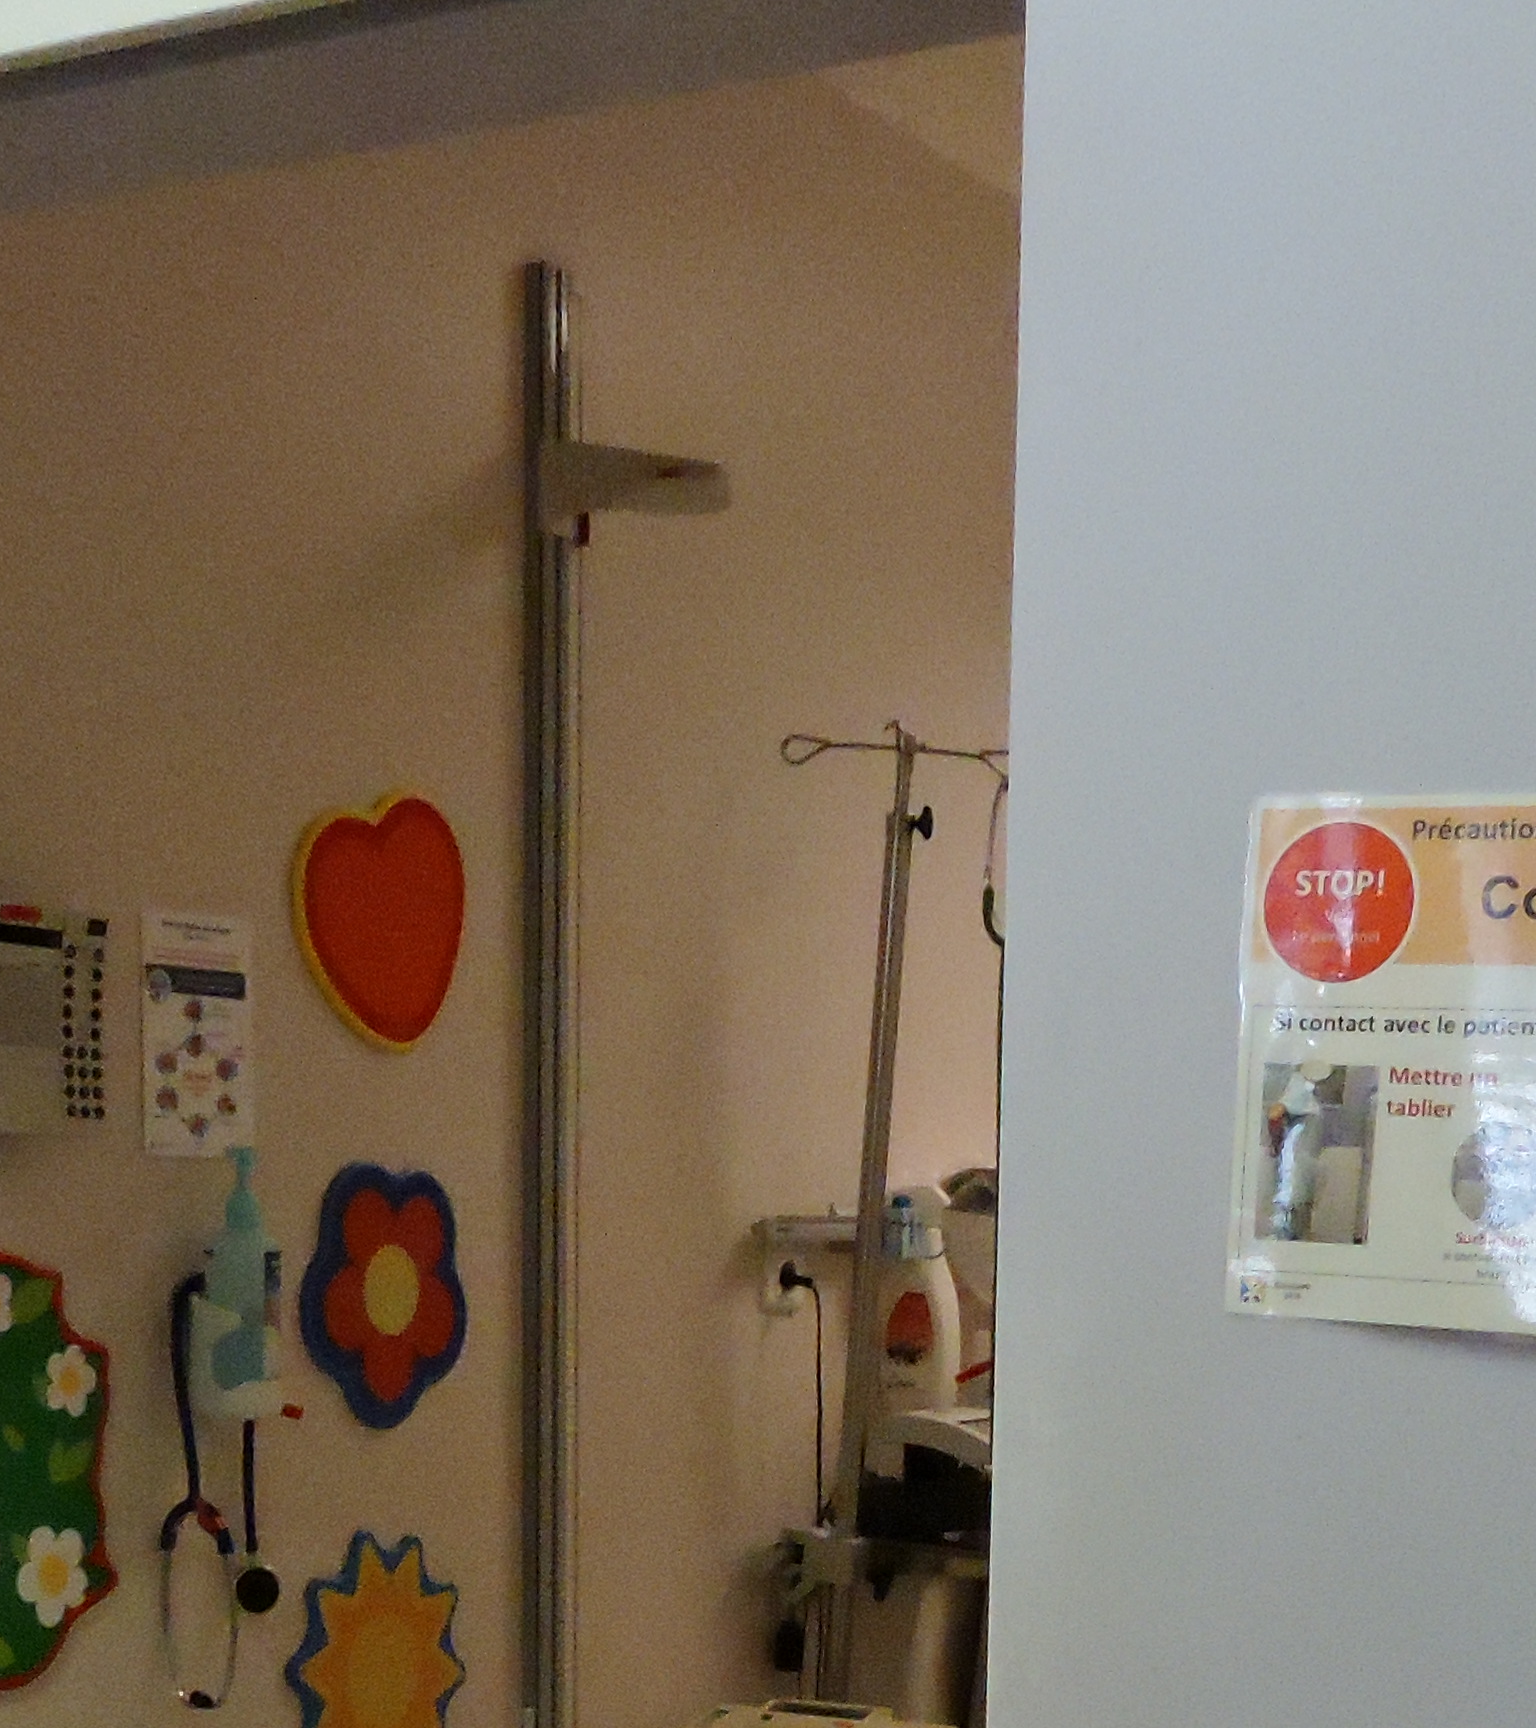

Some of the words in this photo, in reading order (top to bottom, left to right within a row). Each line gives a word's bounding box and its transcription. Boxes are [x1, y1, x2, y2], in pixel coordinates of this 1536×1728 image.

[1295, 869, 1386, 899] STOP!
[1299, 1014, 1376, 1033] contact
[1384, 1018, 1430, 1034] avec
[1437, 1015, 1456, 1035] le
[1389, 1066, 1462, 1087] Mettre
[1387, 1098, 1455, 1118] tablier
